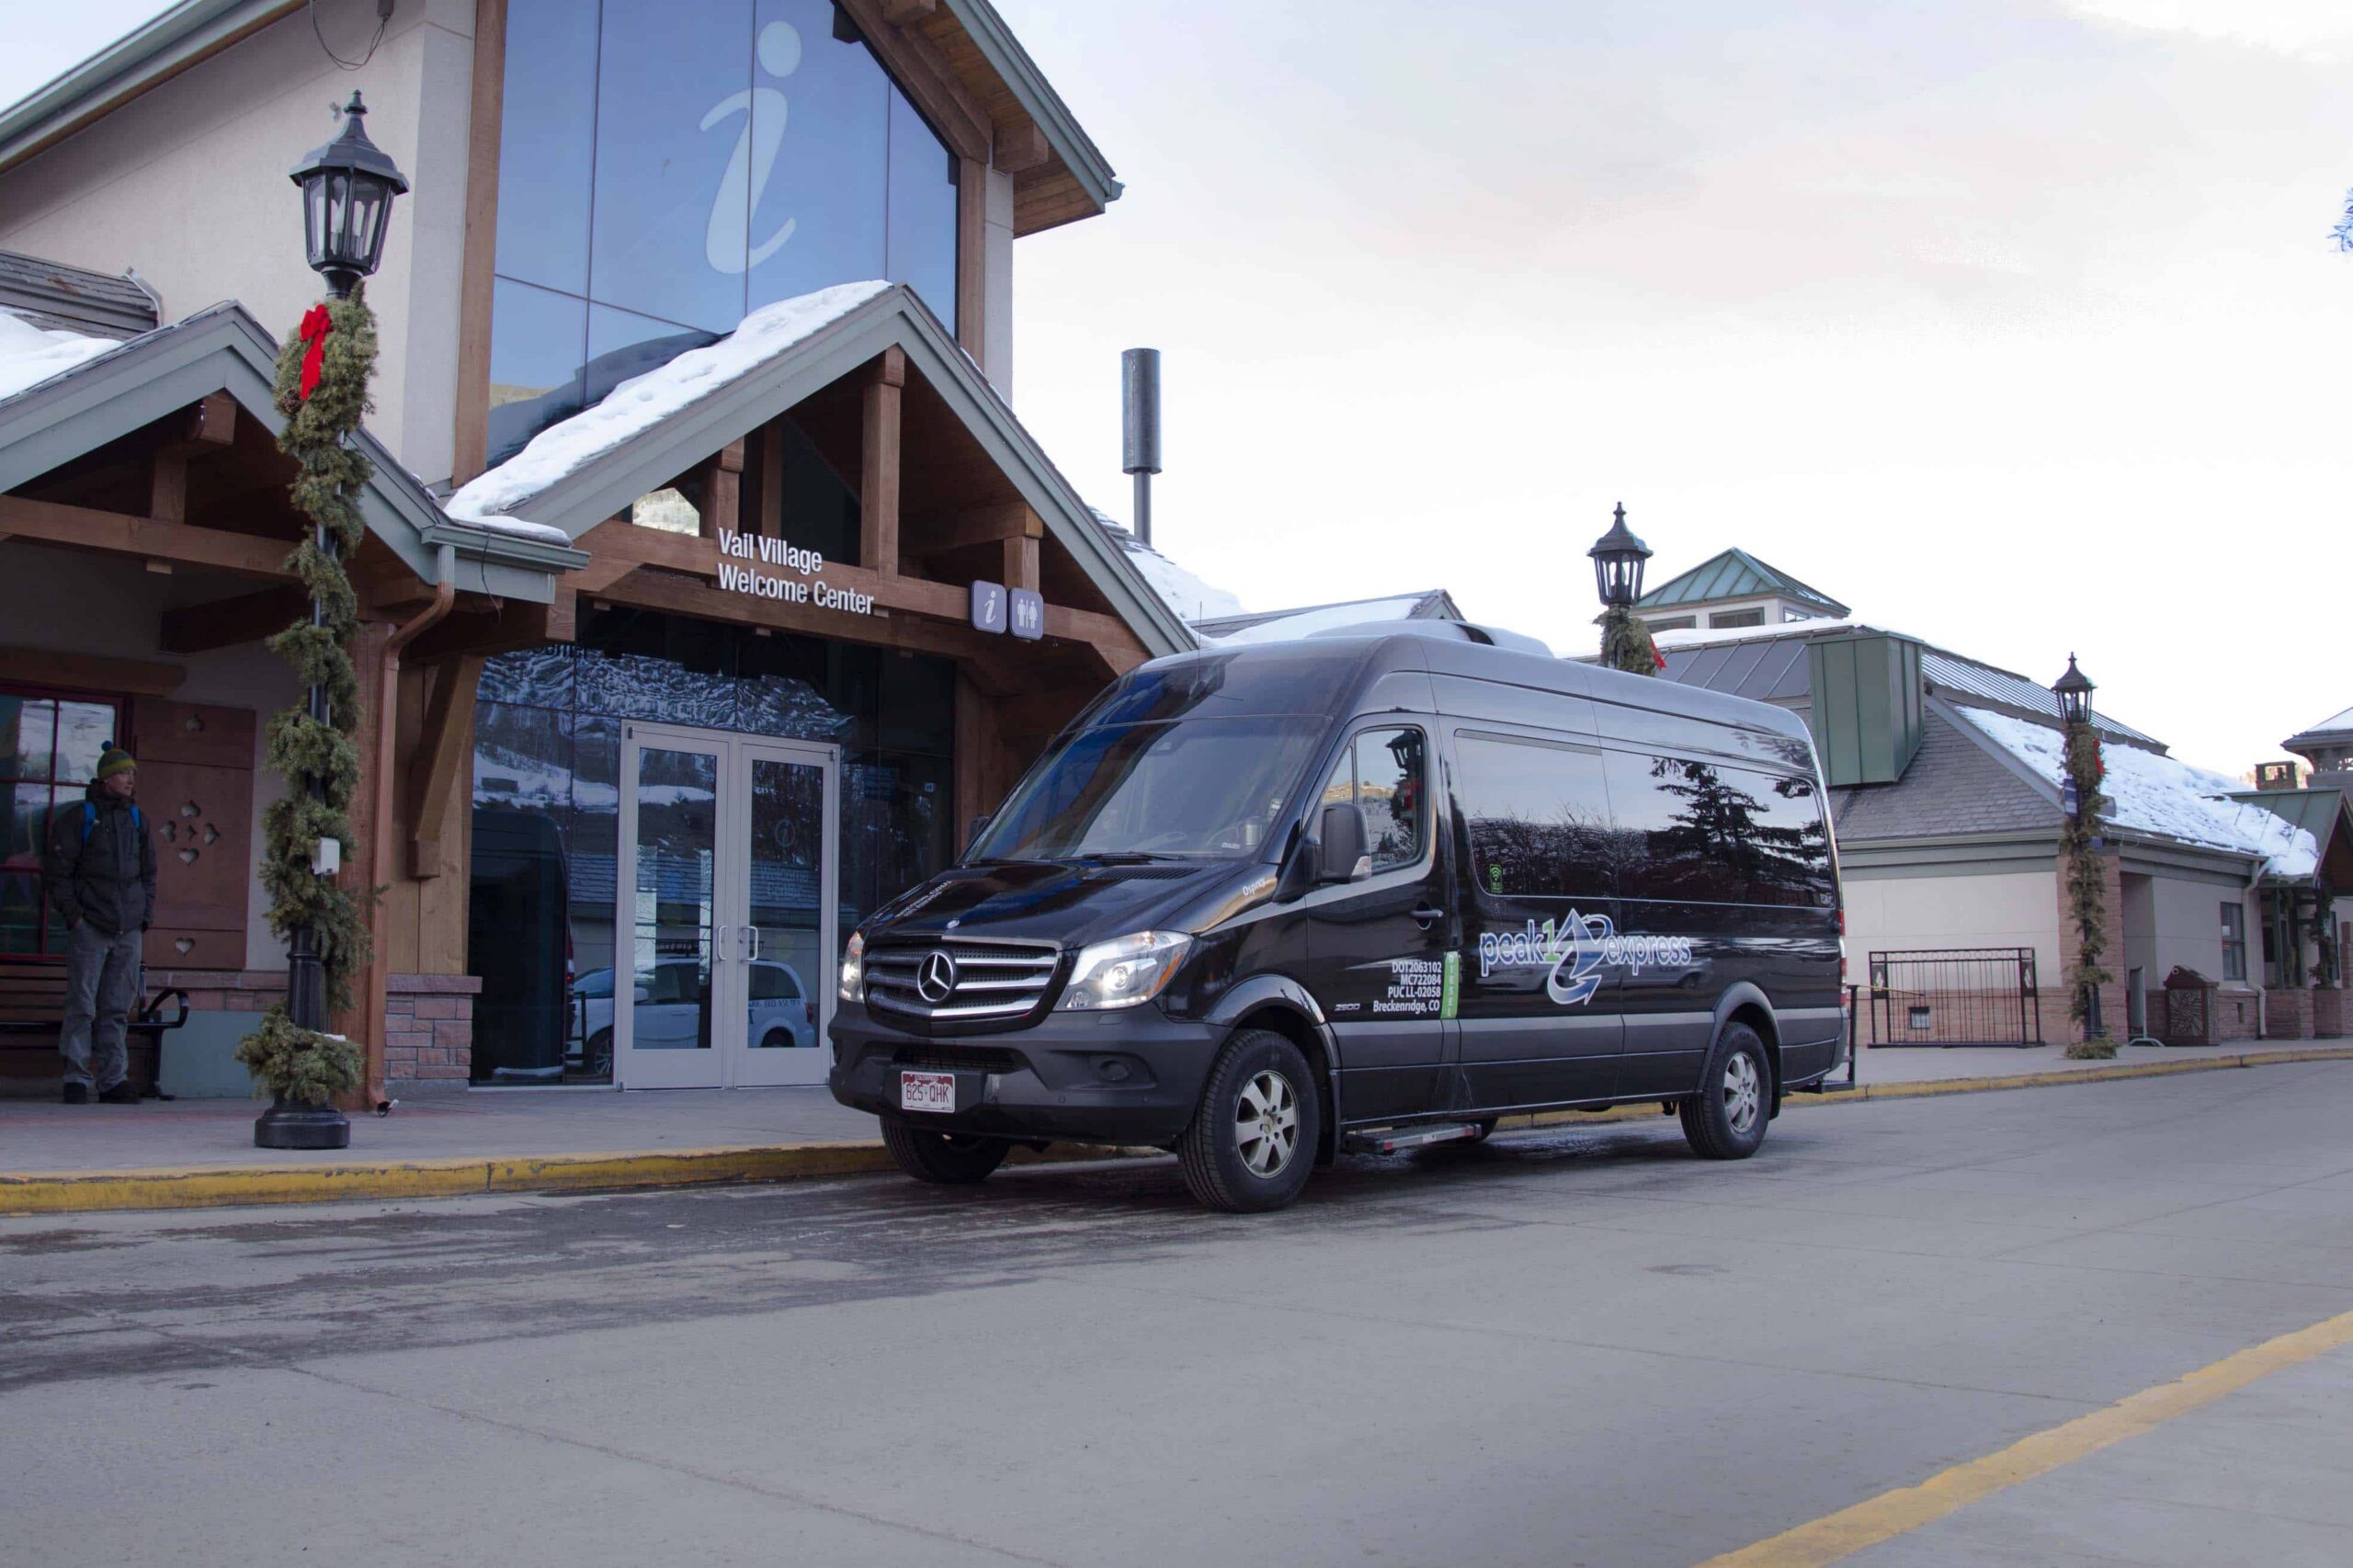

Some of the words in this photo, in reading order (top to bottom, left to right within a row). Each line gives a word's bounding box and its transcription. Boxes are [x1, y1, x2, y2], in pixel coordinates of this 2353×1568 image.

[718, 528, 754, 559] Vail
[758, 535, 823, 575] Village
[718, 562, 808, 603] Welcome
[813, 580, 874, 615] Center
[1605, 935, 1692, 976] express
[1392, 961, 1442, 973] DOT2063102
[1400, 974, 1441, 985] MC722084
[1388, 986, 1405, 998] PUC
[1406, 987, 1441, 998] LL-02058
[1373, 999, 1427, 1015] Breckenridge,
[1428, 1000, 1440, 1011] CO
